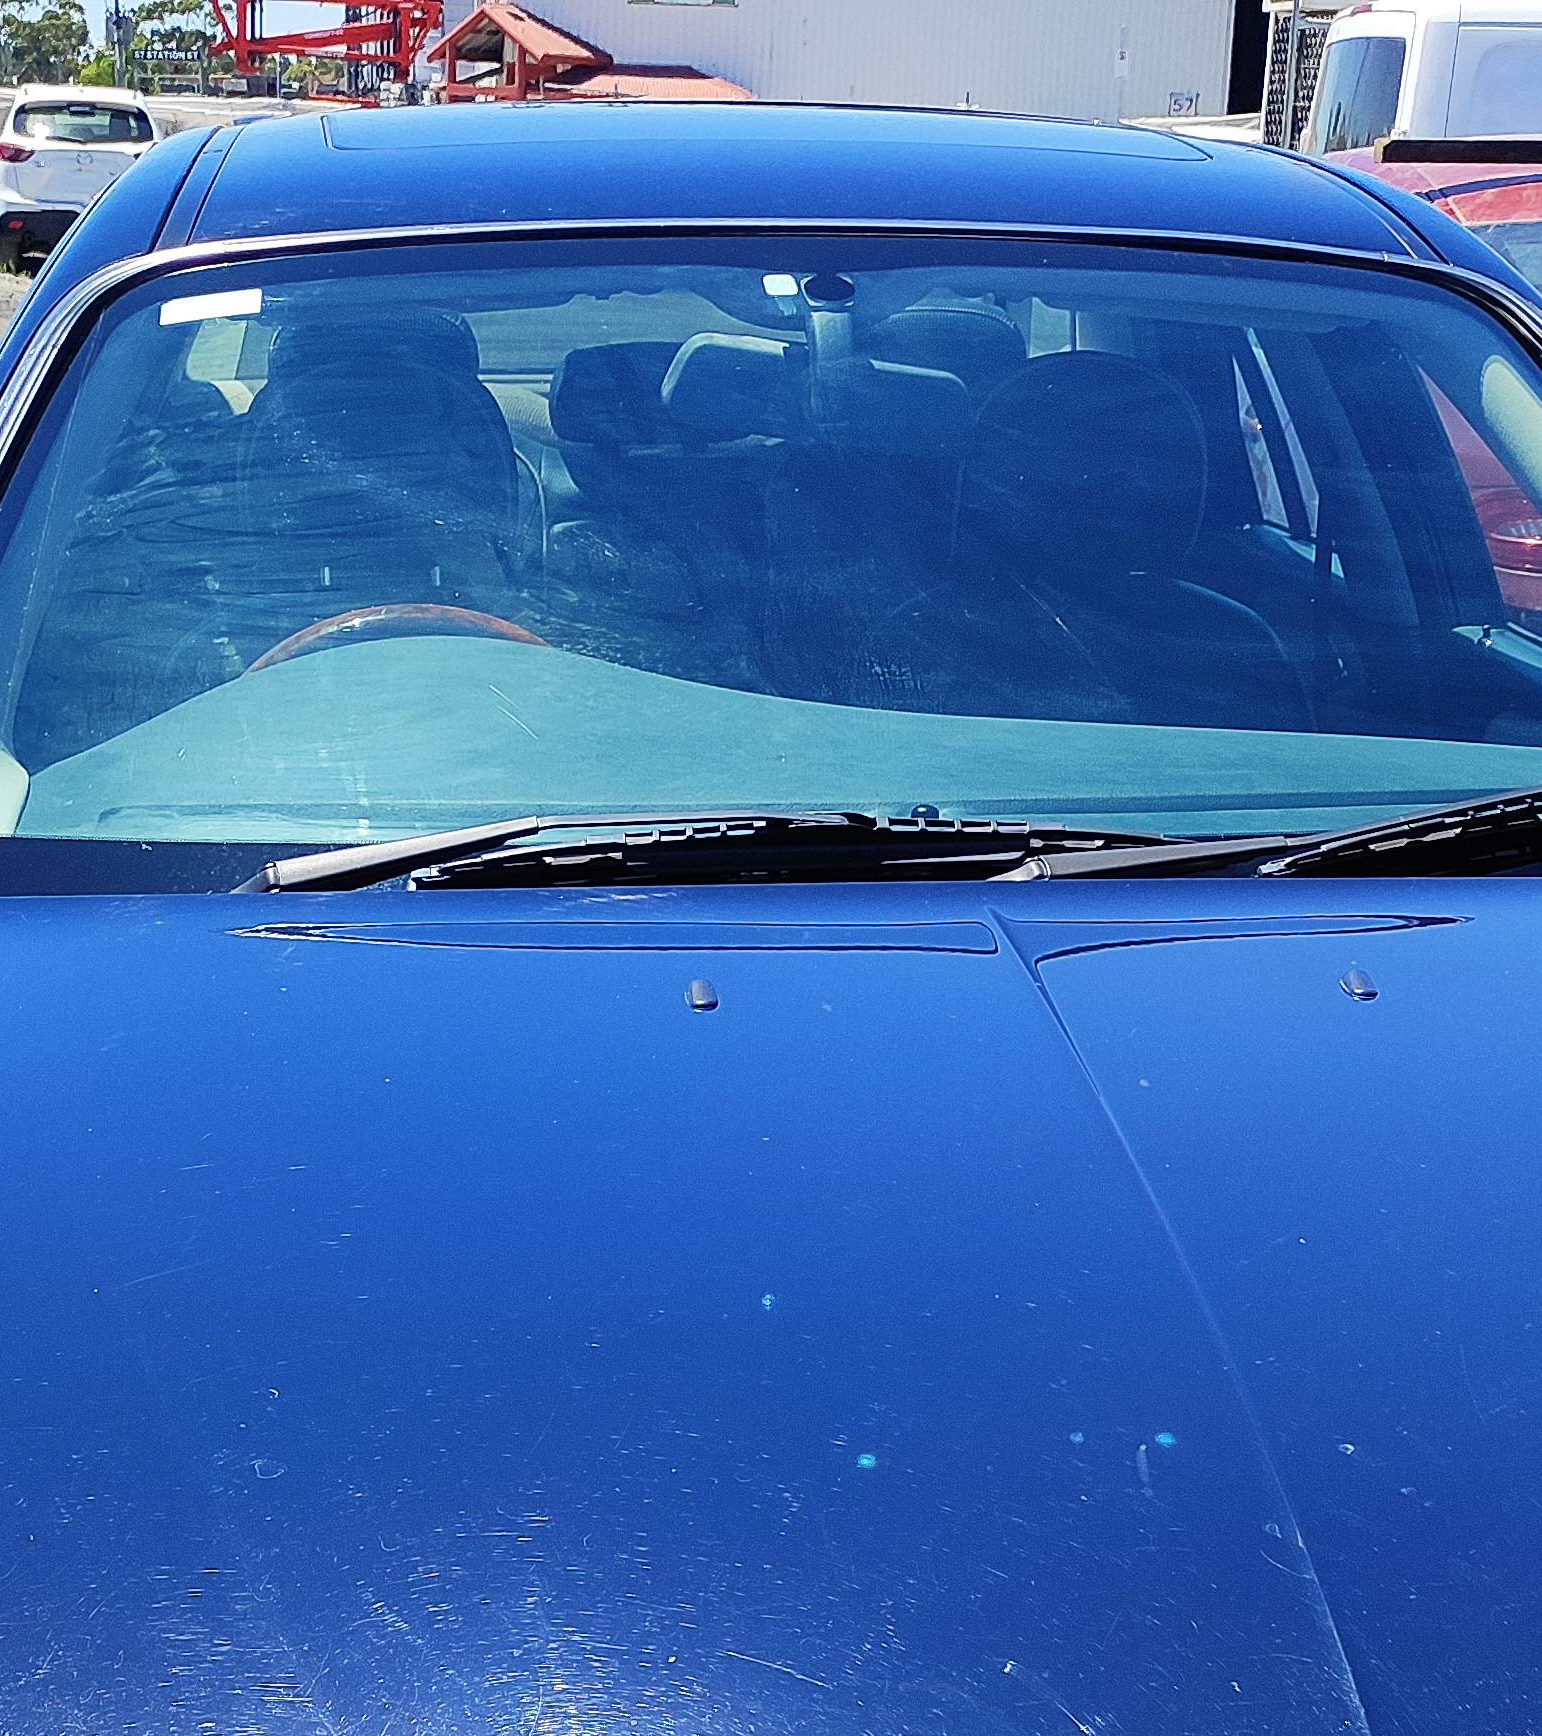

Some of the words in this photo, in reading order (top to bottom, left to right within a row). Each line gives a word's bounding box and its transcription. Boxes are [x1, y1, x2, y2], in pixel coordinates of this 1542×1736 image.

[146, 50, 186, 60] STATION
[187, 50, 199, 60] ST
[1173, 97, 1194, 112] 57
